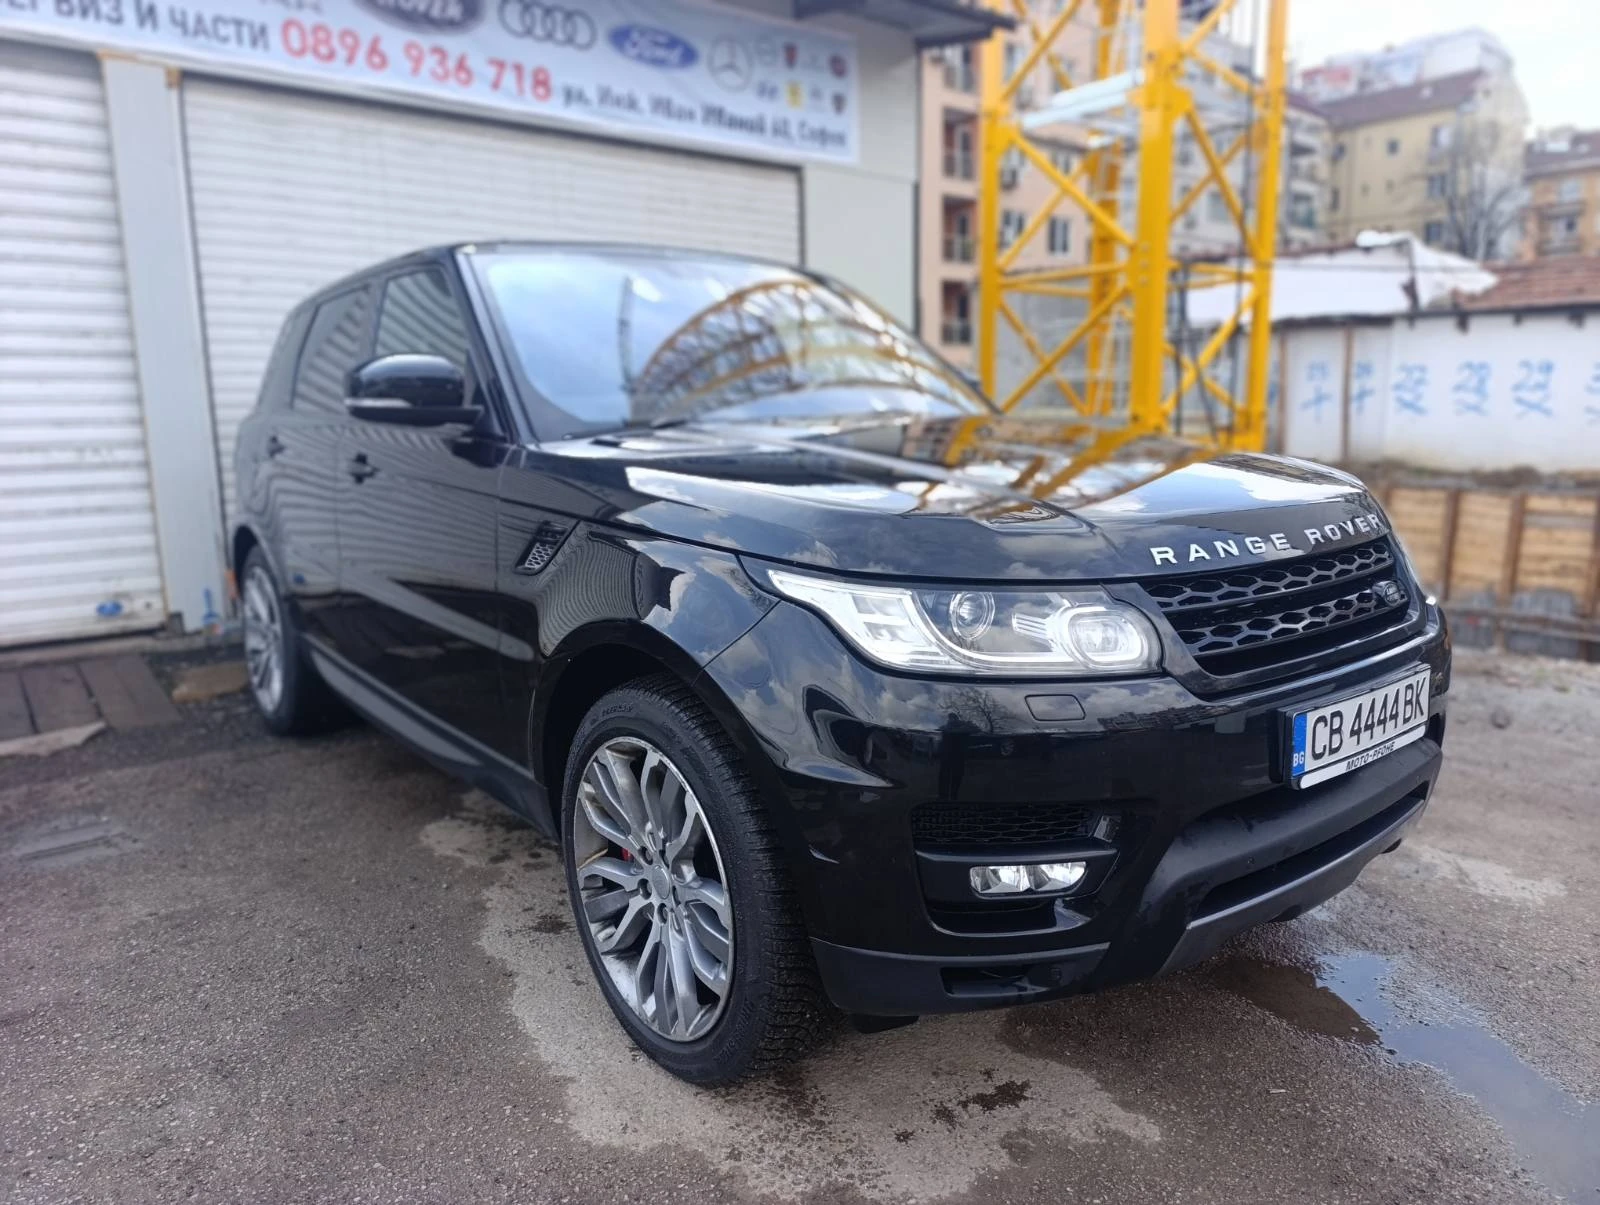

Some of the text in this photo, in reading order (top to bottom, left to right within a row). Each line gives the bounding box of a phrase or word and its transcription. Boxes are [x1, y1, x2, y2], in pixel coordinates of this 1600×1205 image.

[134, 0, 158, 32] И
[167, 7, 270, 51] ЧАСТИ
[281, 18, 391, 72] 0896
[403, 40, 474, 87] 936
[487, 57, 552, 101] 718
[1150, 513, 1383, 566] RANGE ROVER
[1311, 676, 1426, 761] CB 4444 BK
[1292, 751, 1305, 767] BG
